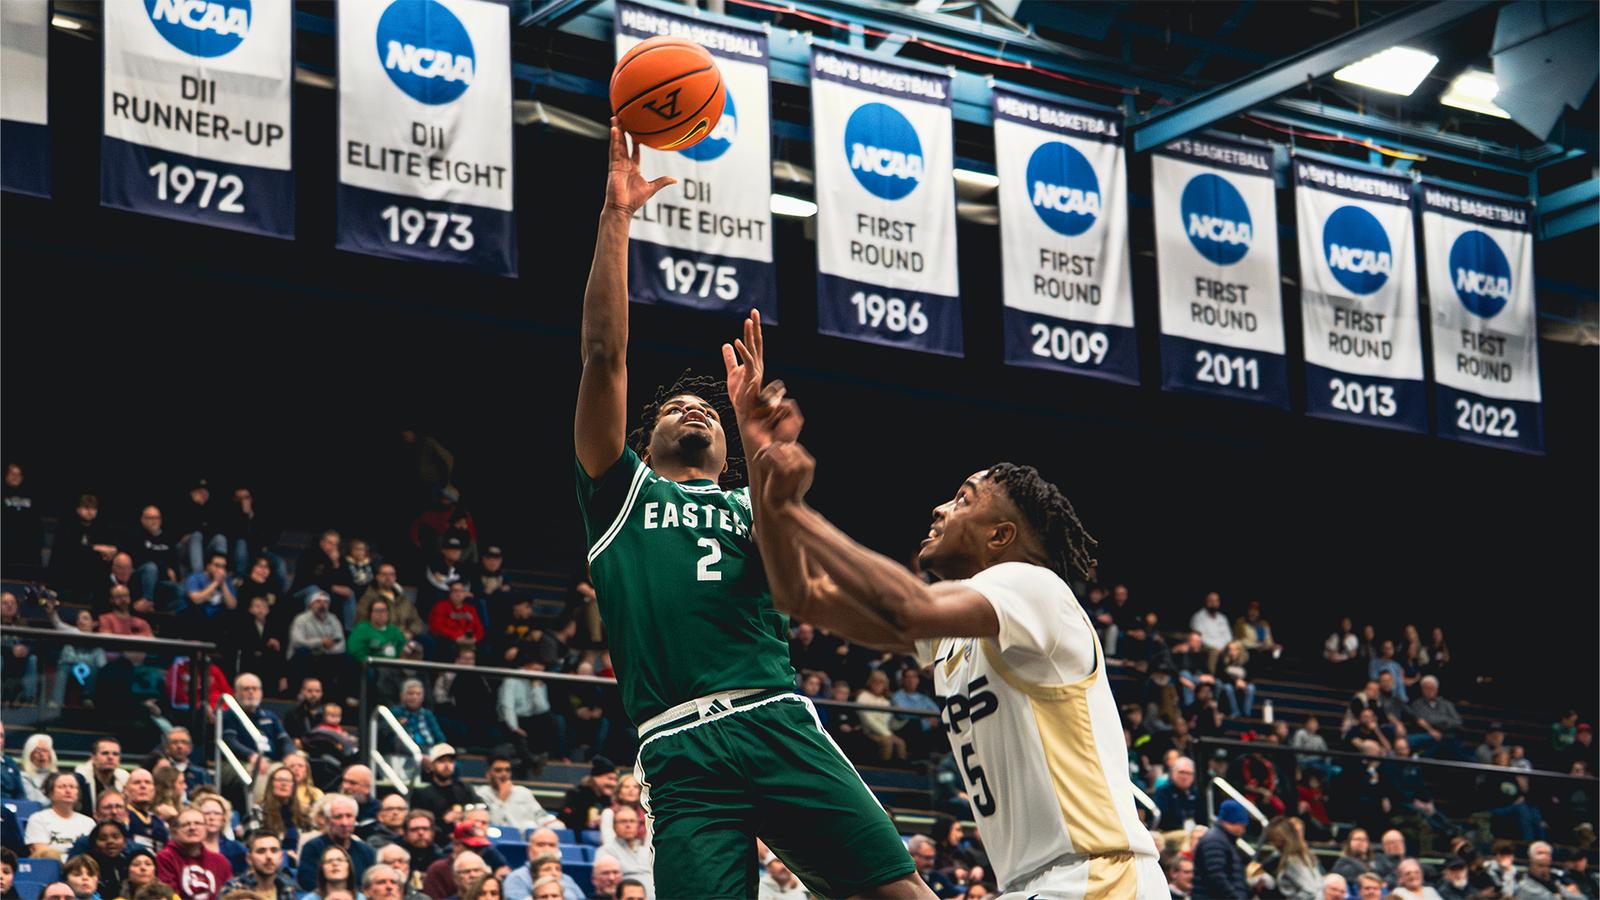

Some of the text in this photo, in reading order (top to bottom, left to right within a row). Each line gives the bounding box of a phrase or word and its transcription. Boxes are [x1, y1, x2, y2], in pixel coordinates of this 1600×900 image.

[153, 0, 250, 38] NCAA
[621, 9, 669, 37] MEN'S
[386, 40, 474, 85] NCAA
[815, 53, 946, 99] MEN'S BASKETBALL
[181, 75, 216, 105] DII
[113, 92, 284, 147] RUNNER-UP
[997, 96, 1039, 122] MEN'S
[412, 122, 444, 150] DII
[348, 141, 506, 189] ELITE EIGHT
[851, 143, 922, 183] NCAA
[1193, 143, 1269, 170] BASKETBALL
[149, 162, 245, 213] 1972
[684, 178, 711, 203] DII
[1033, 181, 1100, 217] NCAA
[1425, 190, 1460, 212] MEN'S
[381, 205, 474, 250] 1973
[632, 203, 766, 241] LITE EIGHT
[857, 213, 916, 242] FIRST
[1189, 213, 1251, 248] NCAA
[850, 240, 924, 273] ROUND
[1040, 248, 1096, 278] FIRST
[1330, 243, 1390, 277] NCAA
[659, 256, 739, 300] 1975
[1034, 274, 1101, 306] ROUND
[1195, 276, 1249, 305] FIRST
[1457, 268, 1509, 301] NCAA
[851, 291, 928, 335] 1986
[1191, 302, 1257, 332] ROUND
[1334, 308, 1386, 334] FIRST
[1031, 323, 1108, 365] 2009
[1329, 331, 1393, 361] ROUND
[1461, 329, 1507, 357] FIRST
[1196, 350, 1258, 390] 2011
[1457, 353, 1512, 383] ROUND
[1330, 378, 1397, 417] 2013
[1456, 398, 1519, 438] 2022
[697, 537, 722, 581] 2
[961, 743, 996, 817] 5
